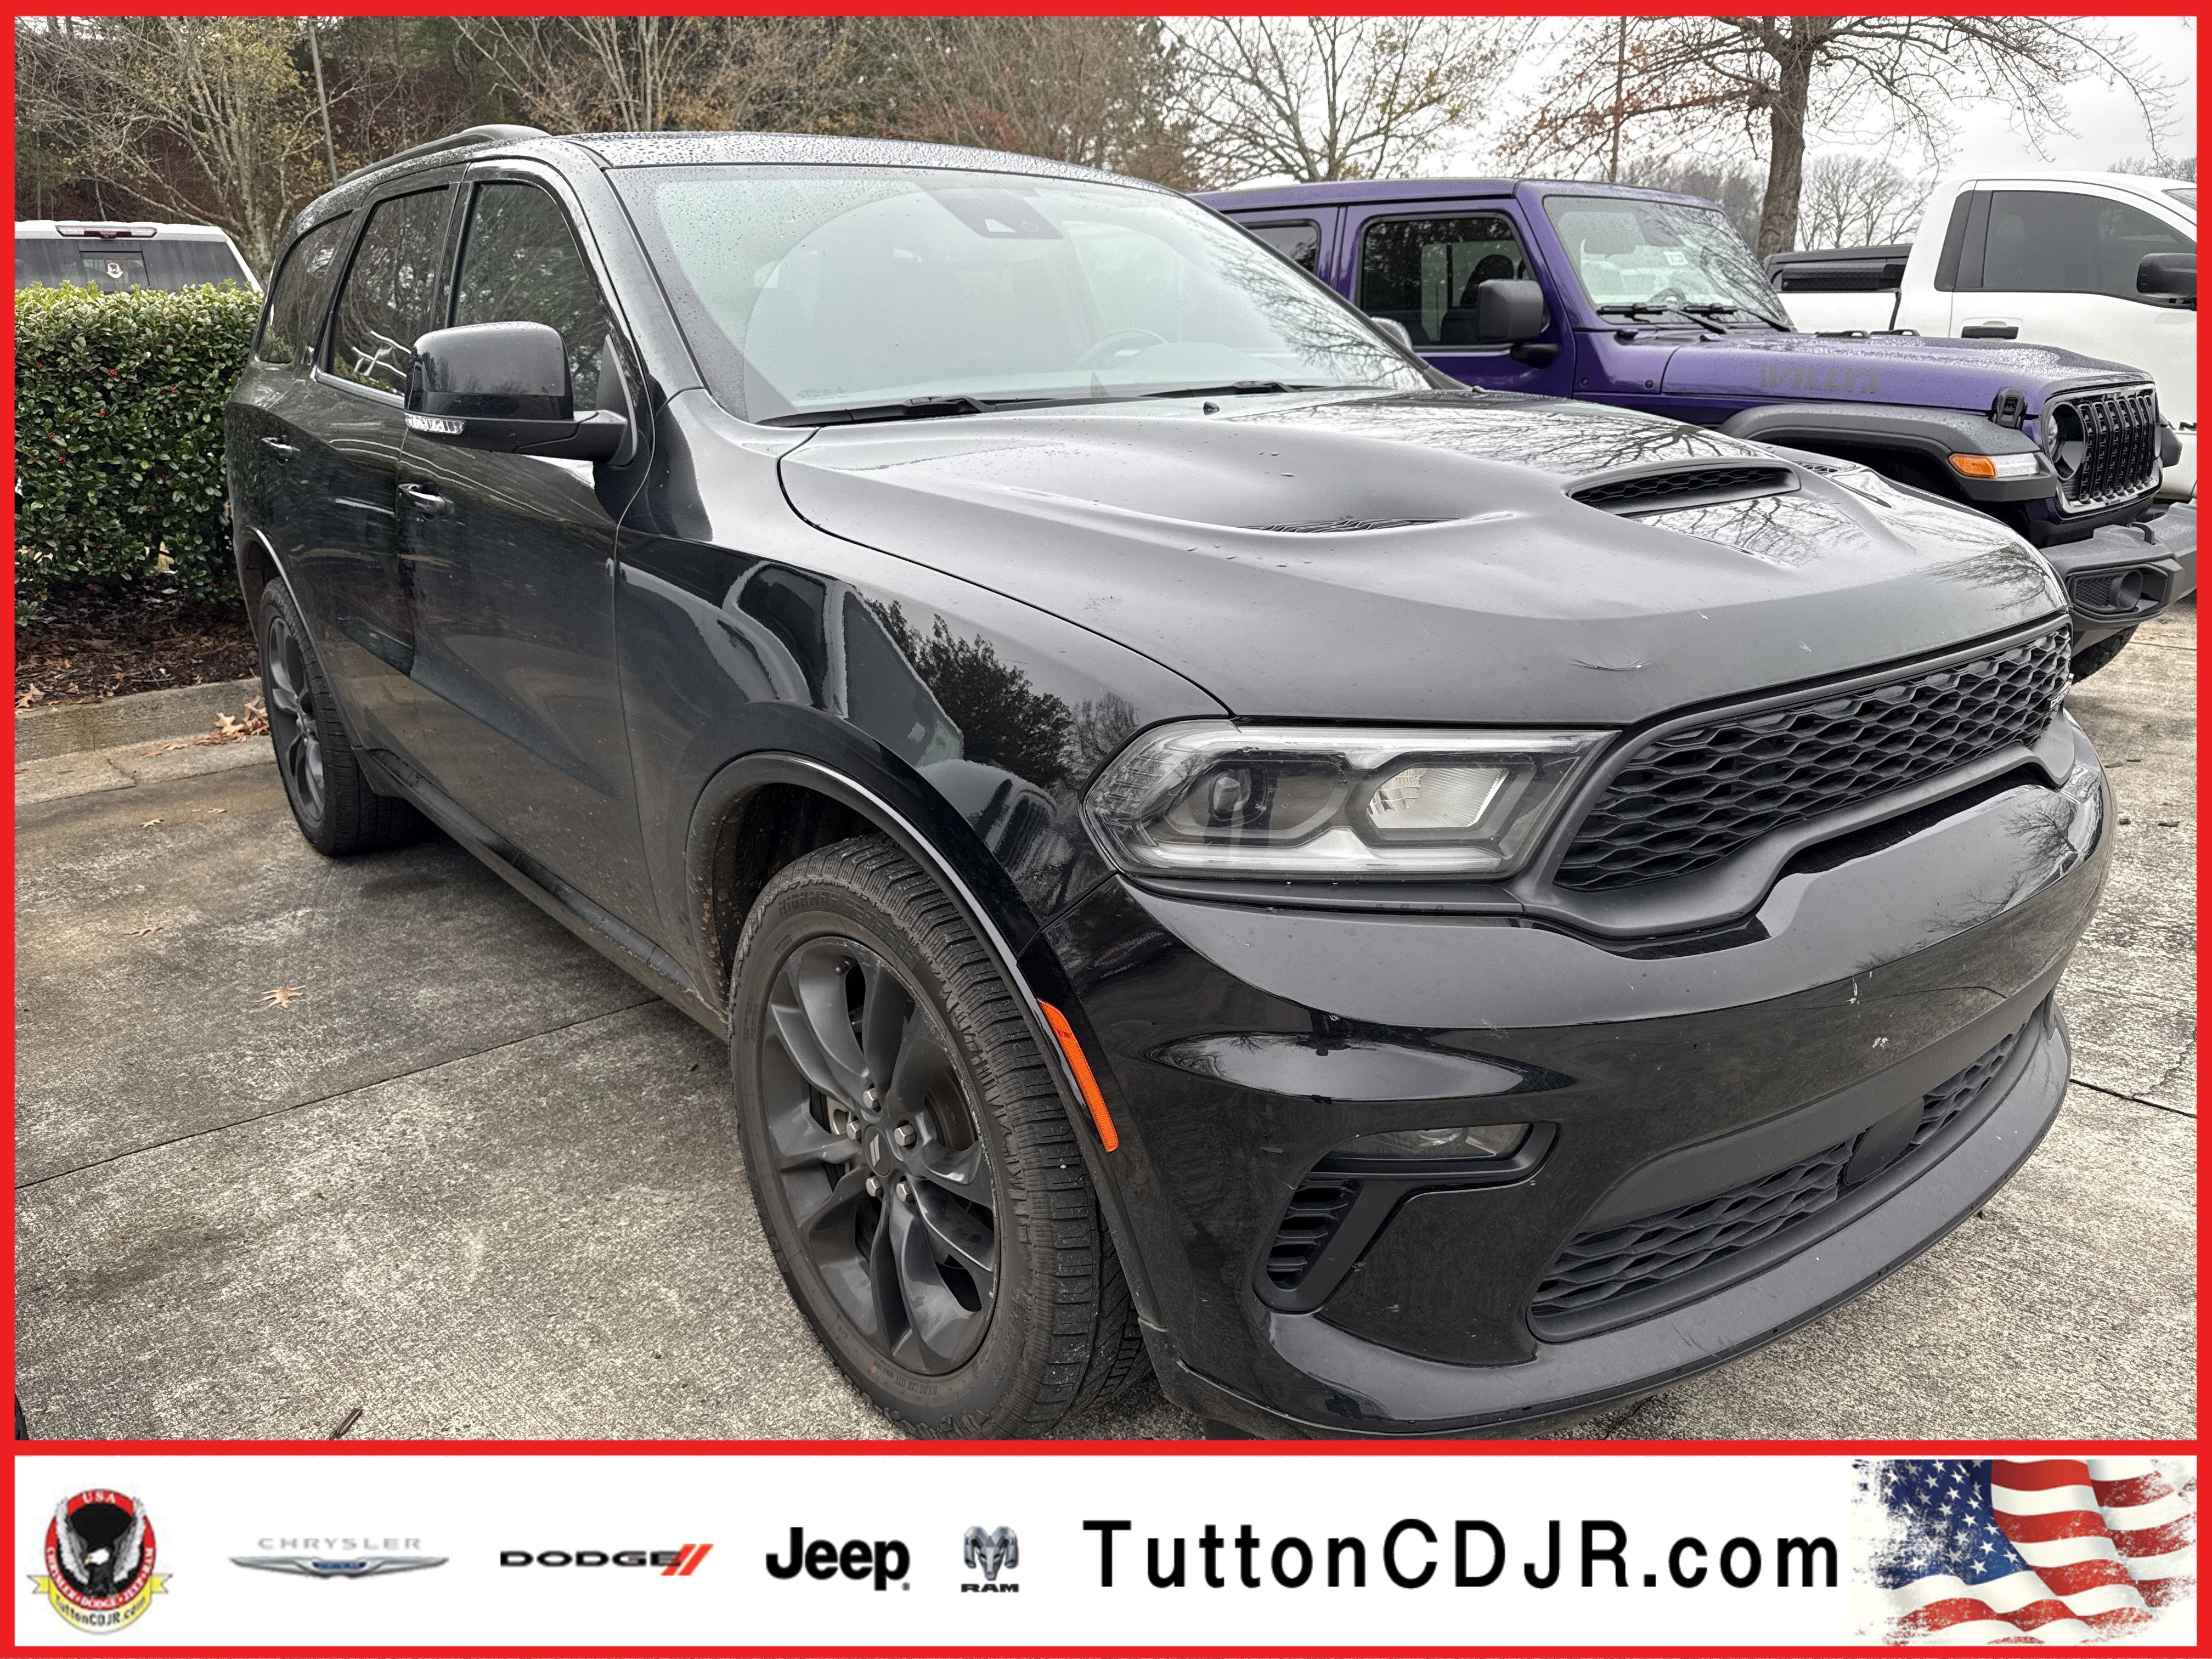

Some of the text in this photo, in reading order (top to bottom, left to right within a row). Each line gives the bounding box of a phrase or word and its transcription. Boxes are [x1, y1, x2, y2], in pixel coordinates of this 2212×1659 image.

[1760, 364, 1886, 394] WILLYS
[778, 889, 839, 917] HIGHWAY
[844, 897, 919, 970] TERRAIN
